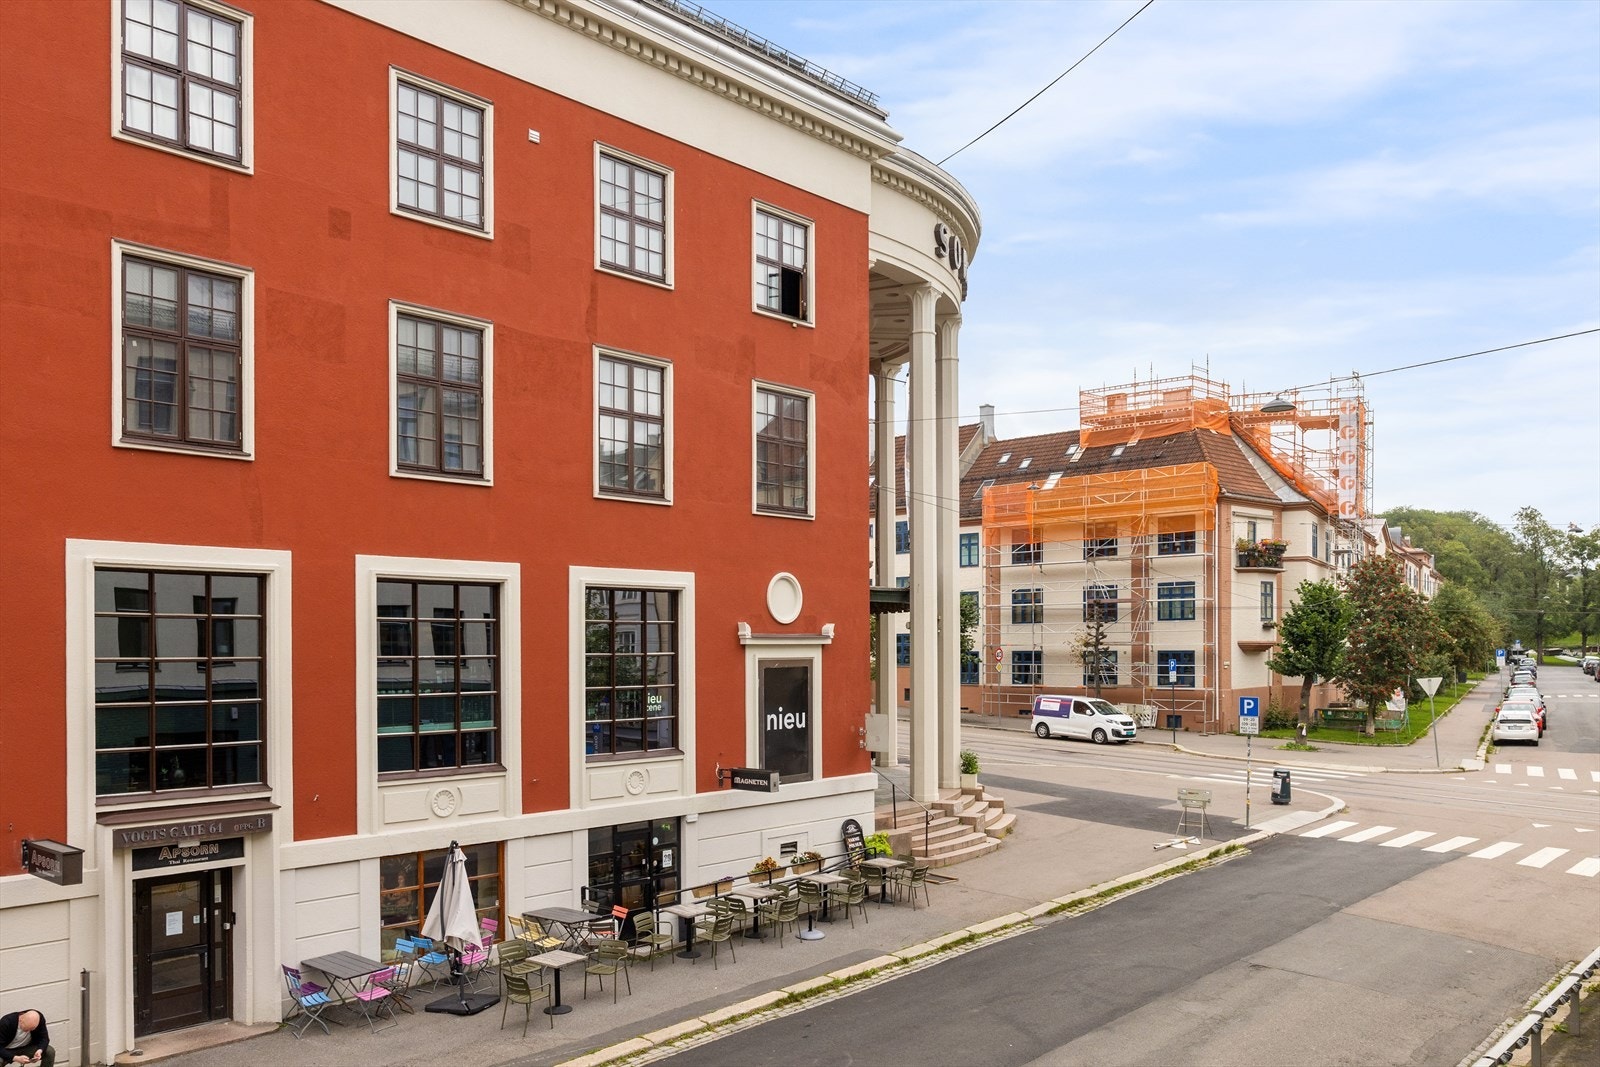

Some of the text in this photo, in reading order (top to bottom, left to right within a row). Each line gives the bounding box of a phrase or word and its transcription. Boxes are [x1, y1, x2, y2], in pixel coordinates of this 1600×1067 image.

[1170, 660, 1174, 670] P
[647, 692, 662, 704] ieu
[1244, 699, 1254, 714] P
[766, 706, 806, 730] nieu
[733, 776, 768, 786] MAGNETEN
[121, 828, 166, 843] VOGTS
[170, 823, 206, 839] GATE
[256, 817, 266, 828] B
